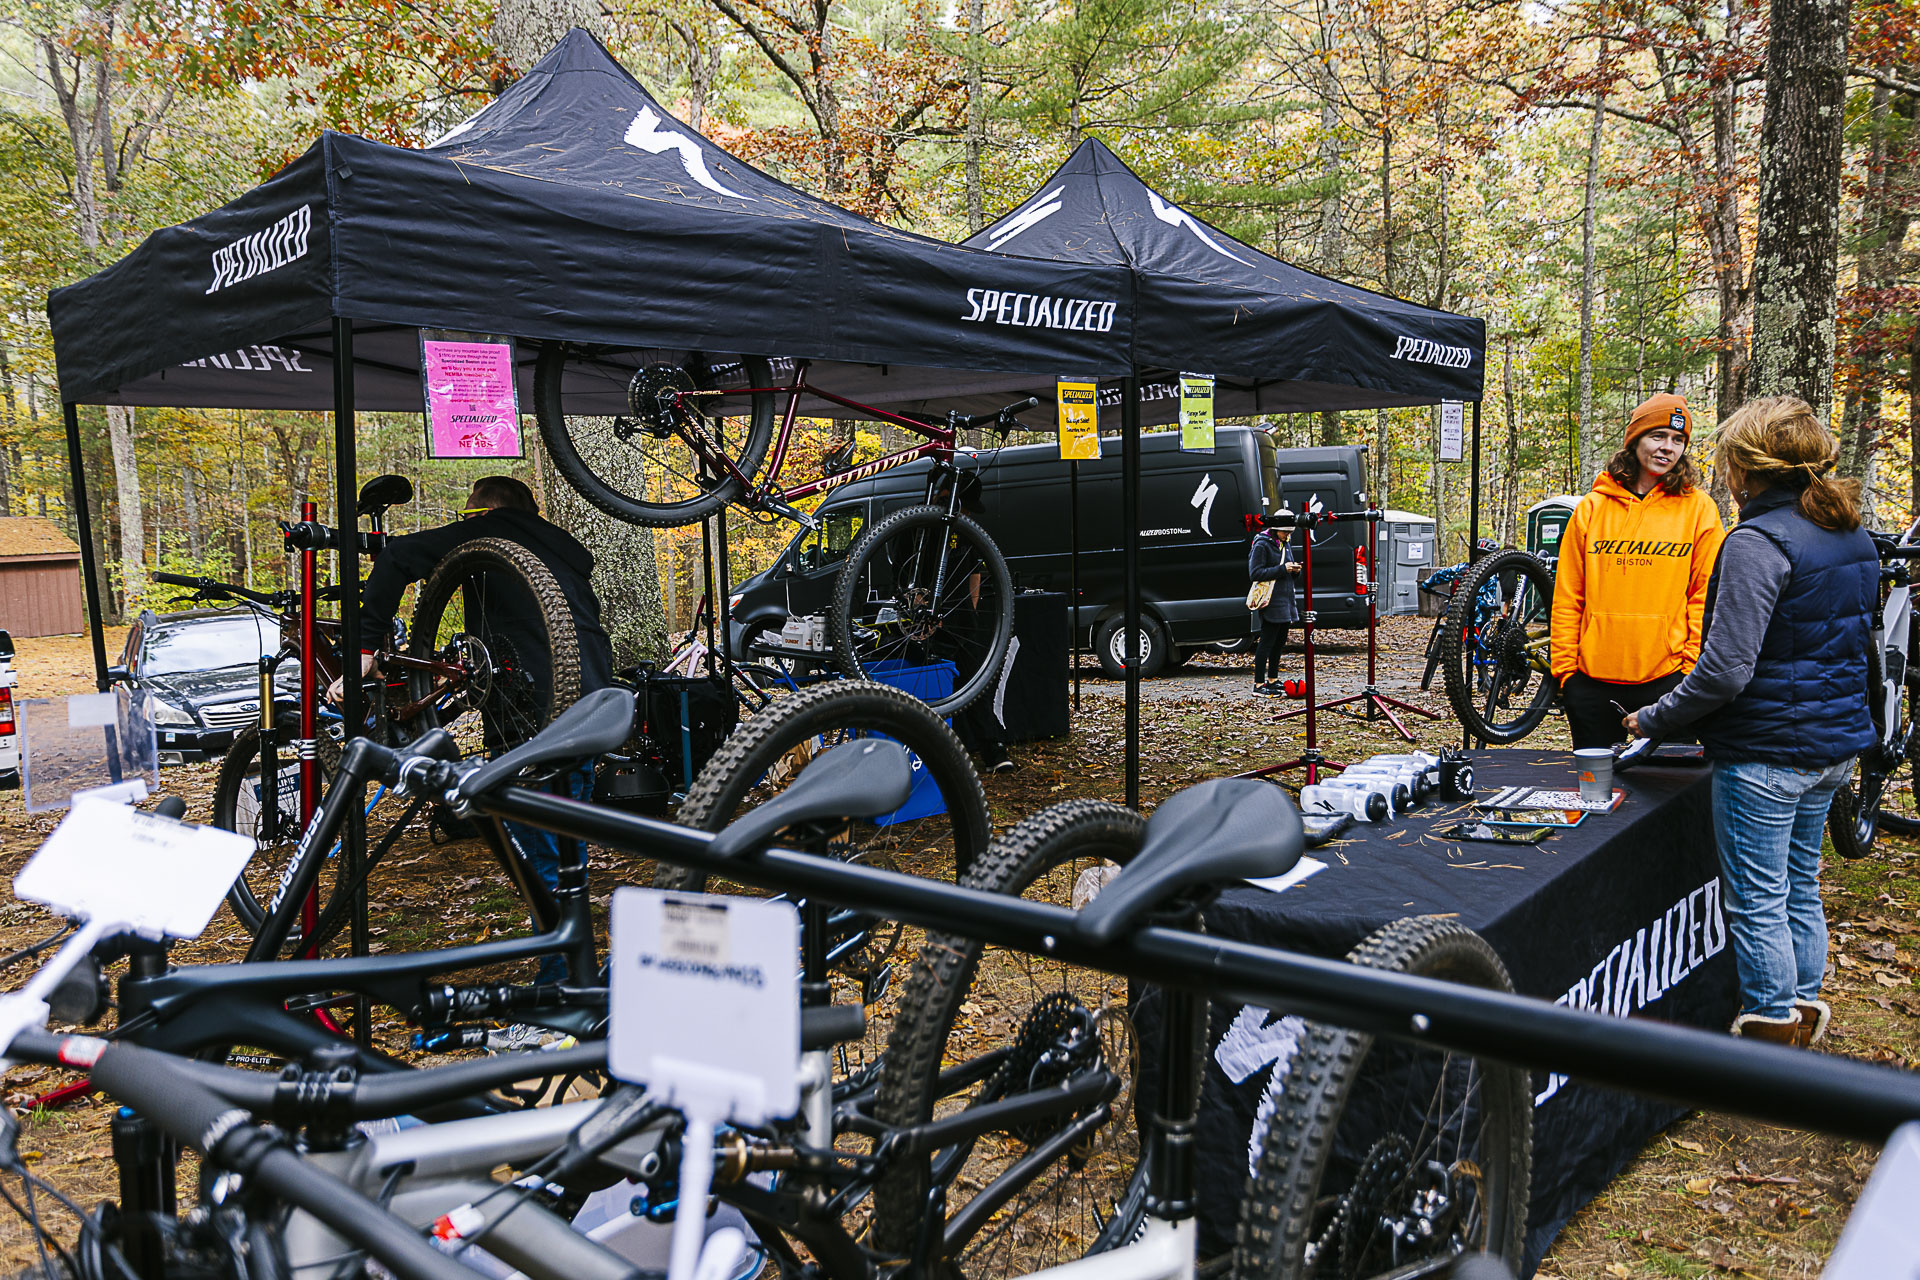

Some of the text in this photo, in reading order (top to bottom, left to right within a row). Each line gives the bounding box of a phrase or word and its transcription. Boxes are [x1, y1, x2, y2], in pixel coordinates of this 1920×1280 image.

[206, 203, 311, 295] SPECIALIZED
[961, 288, 1117, 332] SPECIALIZED
[1389, 335, 1472, 369] SPECIALIZED
[1063, 390, 1094, 399] SPECIALIZED
[450, 415, 498, 423] SPECIALIZED
[815, 449, 920, 492] SPECIALIZED
[1587, 539, 1693, 557] SPECIALIZED
[1616, 558, 1653, 566] BOSTON
[270, 805, 325, 915] FEEDBACK
